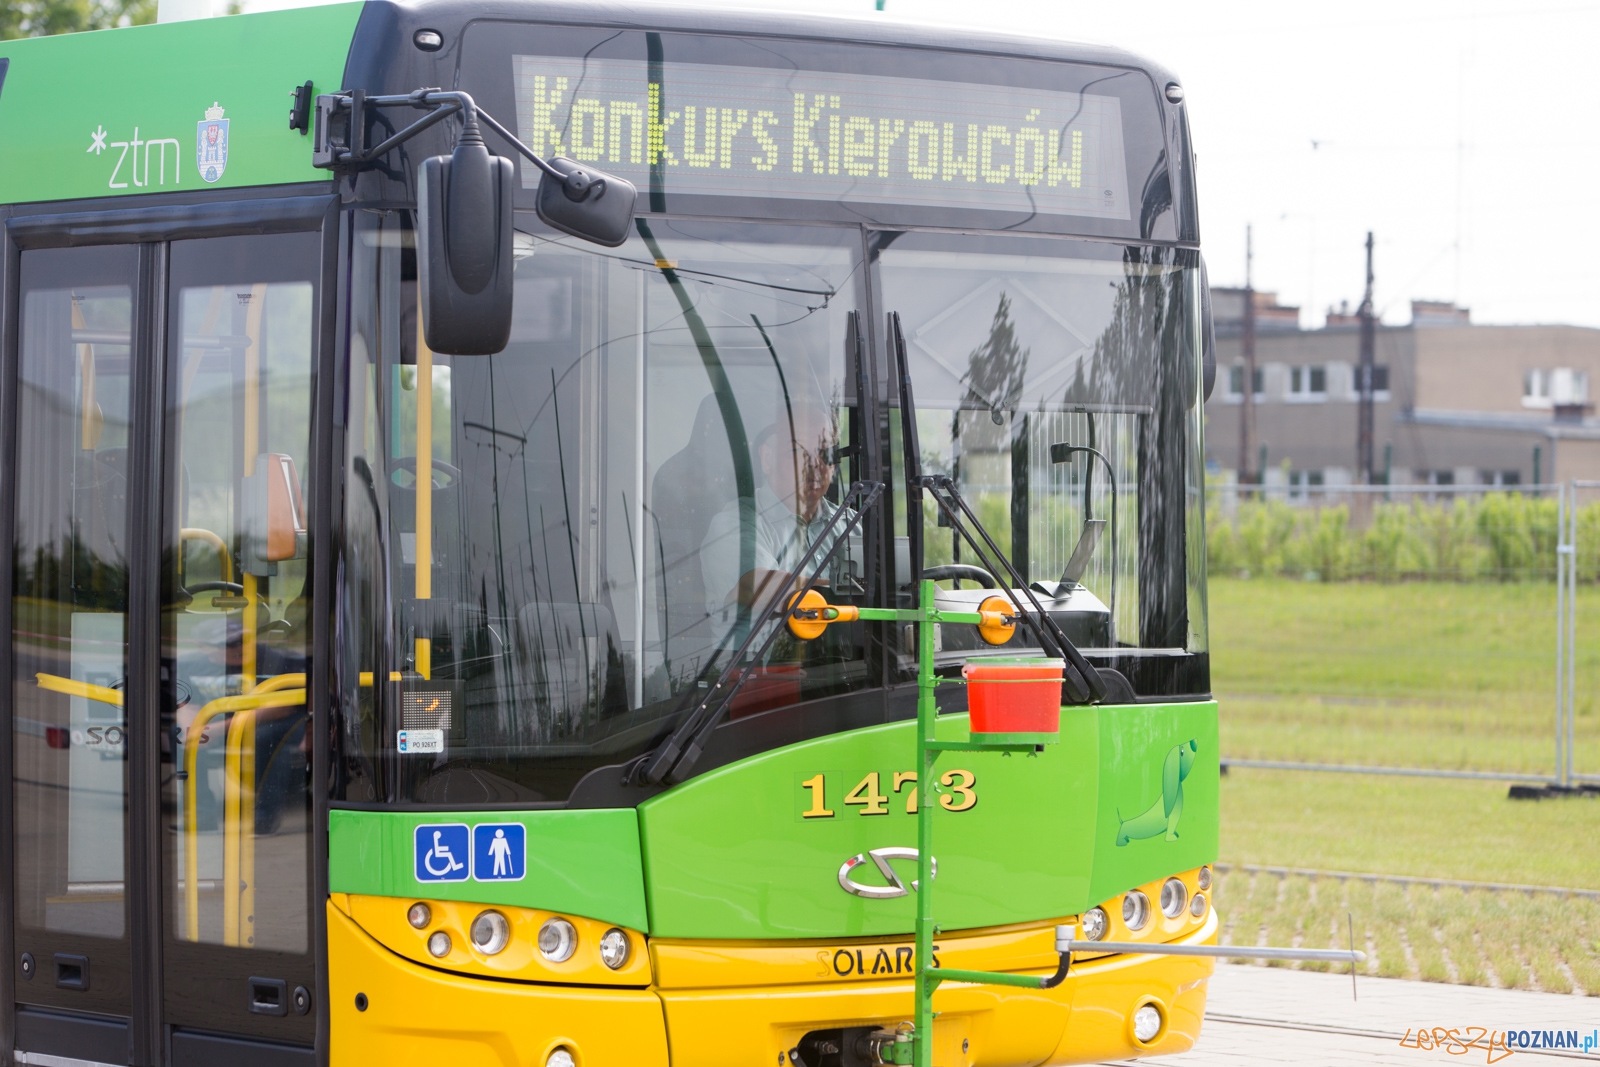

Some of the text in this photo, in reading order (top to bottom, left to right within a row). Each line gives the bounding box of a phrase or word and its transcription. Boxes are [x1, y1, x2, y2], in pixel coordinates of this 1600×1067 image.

[533, 75, 1083, 188] Konkurs Kierowców
[802, 769, 978, 819] 1473
